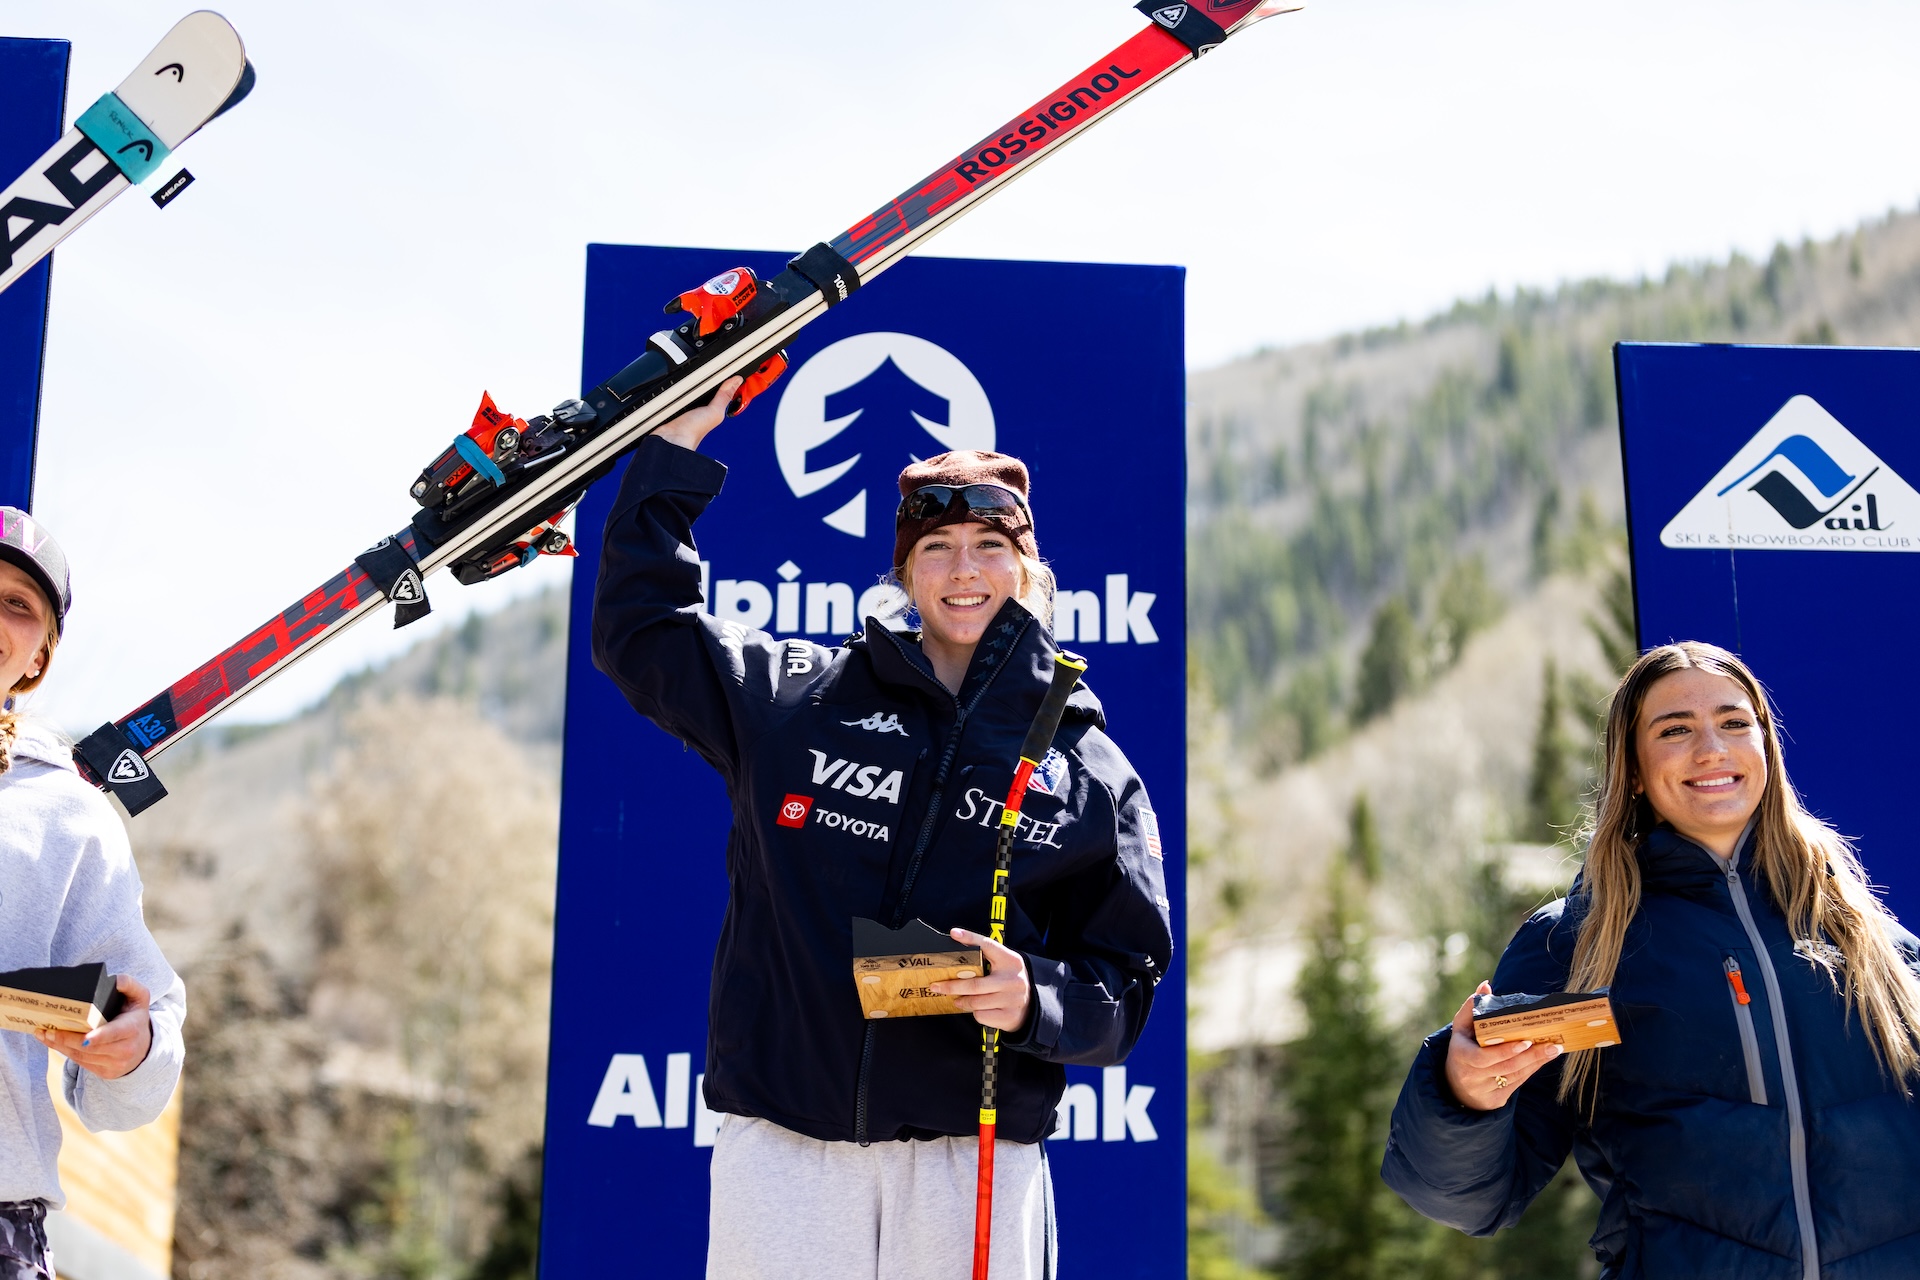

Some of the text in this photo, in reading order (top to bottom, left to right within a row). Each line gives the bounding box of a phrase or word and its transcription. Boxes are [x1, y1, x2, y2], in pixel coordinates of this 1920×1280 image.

[160, 176, 187, 201] HEAD
[1674, 533, 1702, 545] SKI
[1708, 533, 1720, 544] &
[1727, 533, 1856, 547] SNOWBOARD
[1862, 536, 1911, 548] CLUB
[136, 713, 167, 740] A30
[807, 748, 904, 805] VISA
[815, 808, 890, 842] TOYOTA
[955, 787, 1063, 850] STFEL
[909, 957, 935, 967] VAIL
[8, 994, 40, 1006] JUNIORS
[45, 1001, 59, 1010] 2nd
[60, 1004, 82, 1014] PLACE
[1489, 1019, 1511, 1027] TOYOTA
[1523, 1013, 1541, 1021] Alpine
[1541, 1010, 1563, 1018] National
[1564, 1003, 1607, 1014] Championships
